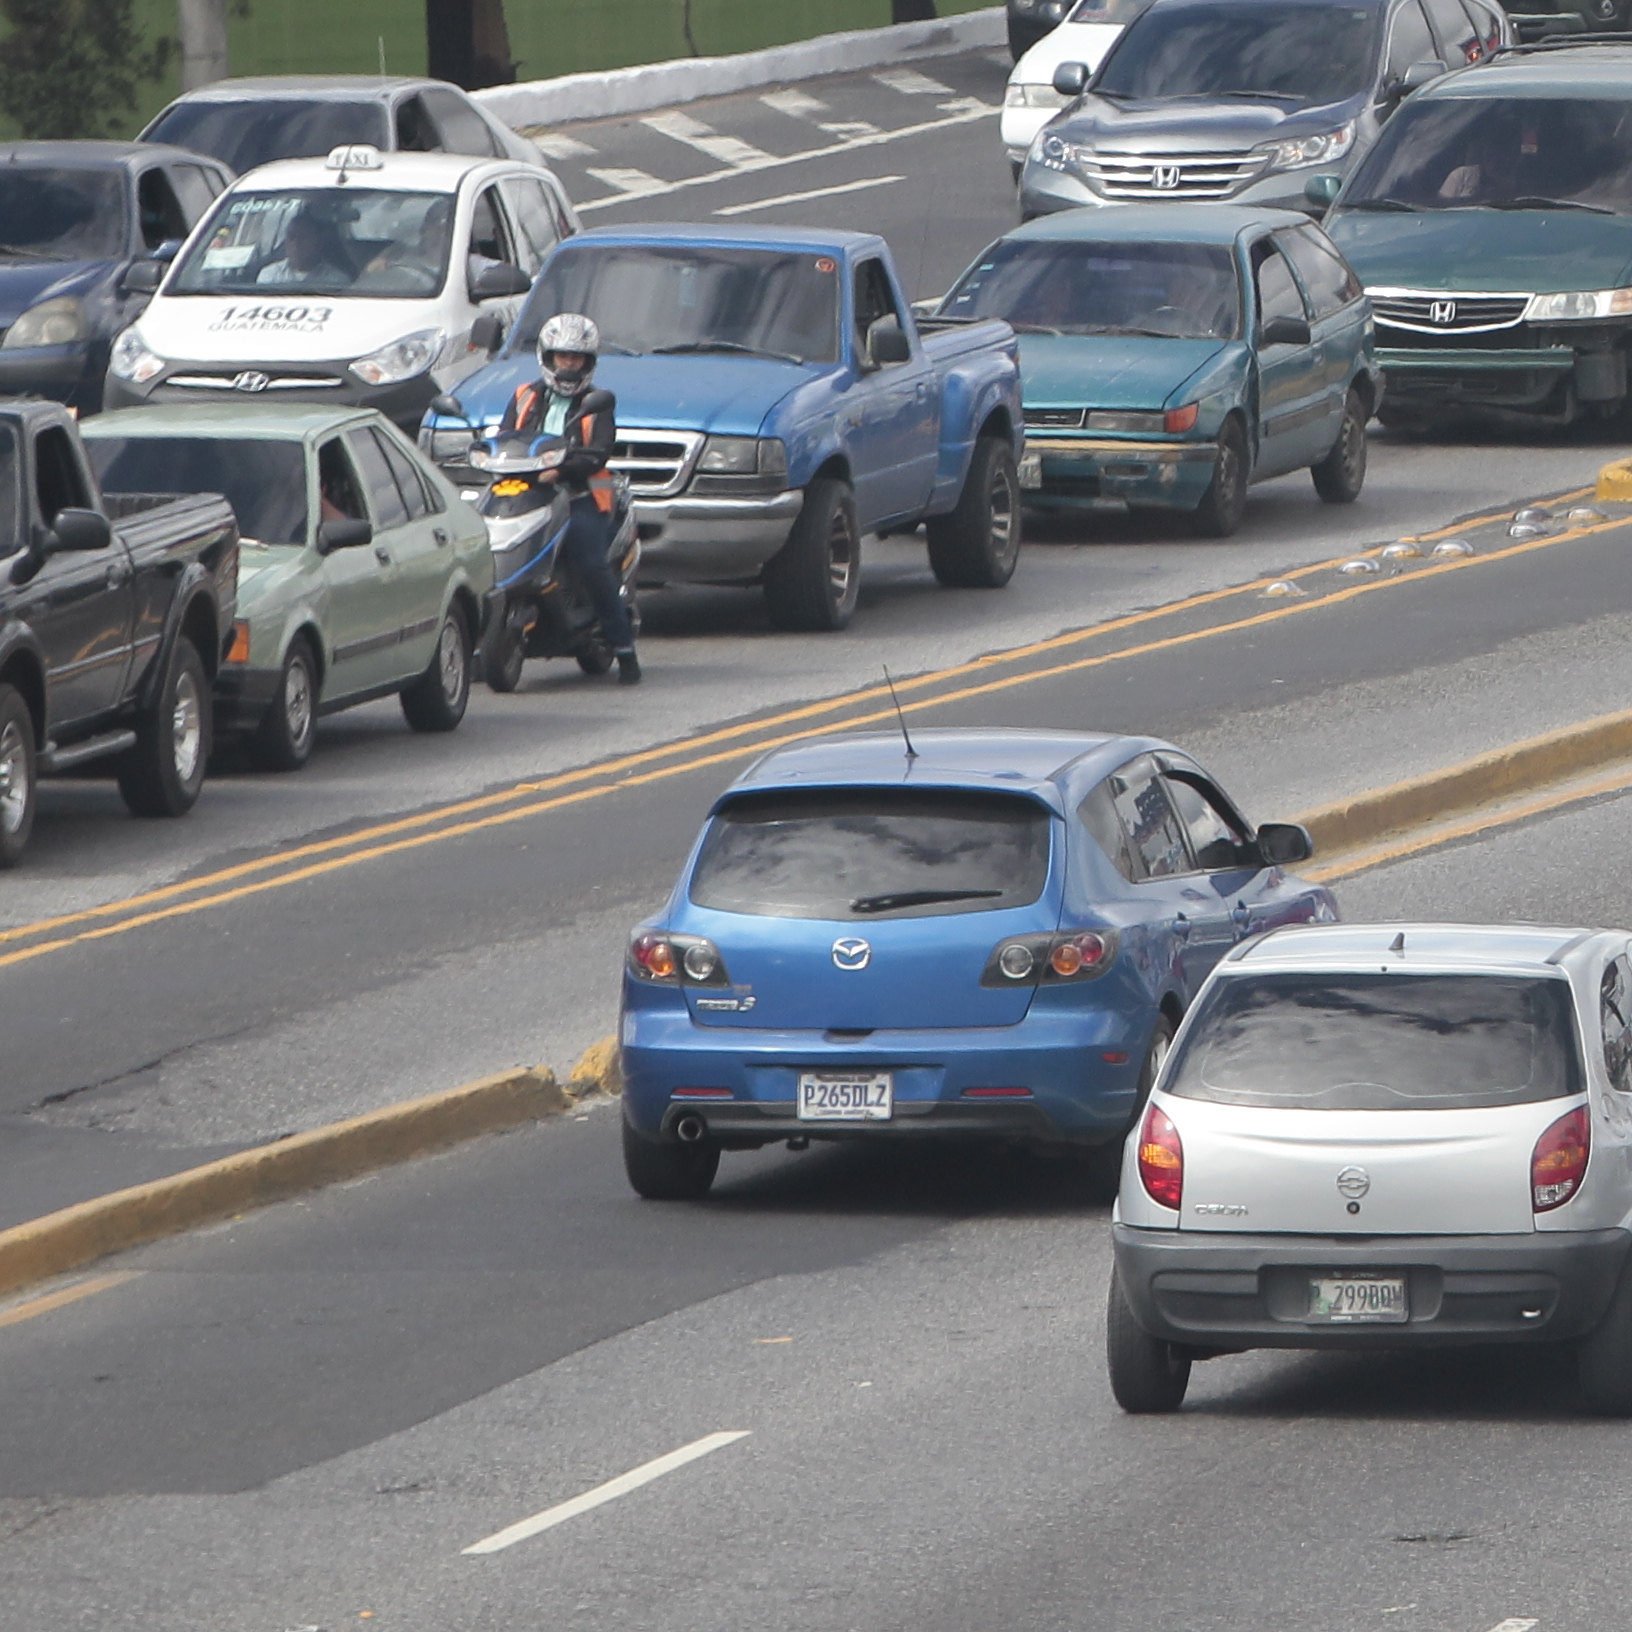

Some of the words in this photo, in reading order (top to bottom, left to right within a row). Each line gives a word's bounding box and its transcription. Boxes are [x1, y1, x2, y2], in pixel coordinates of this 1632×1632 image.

[220, 305, 334, 323] 14603
[207, 321, 325, 334] GUATEMALA
[804, 1085, 887, 1108] P265DLZ
